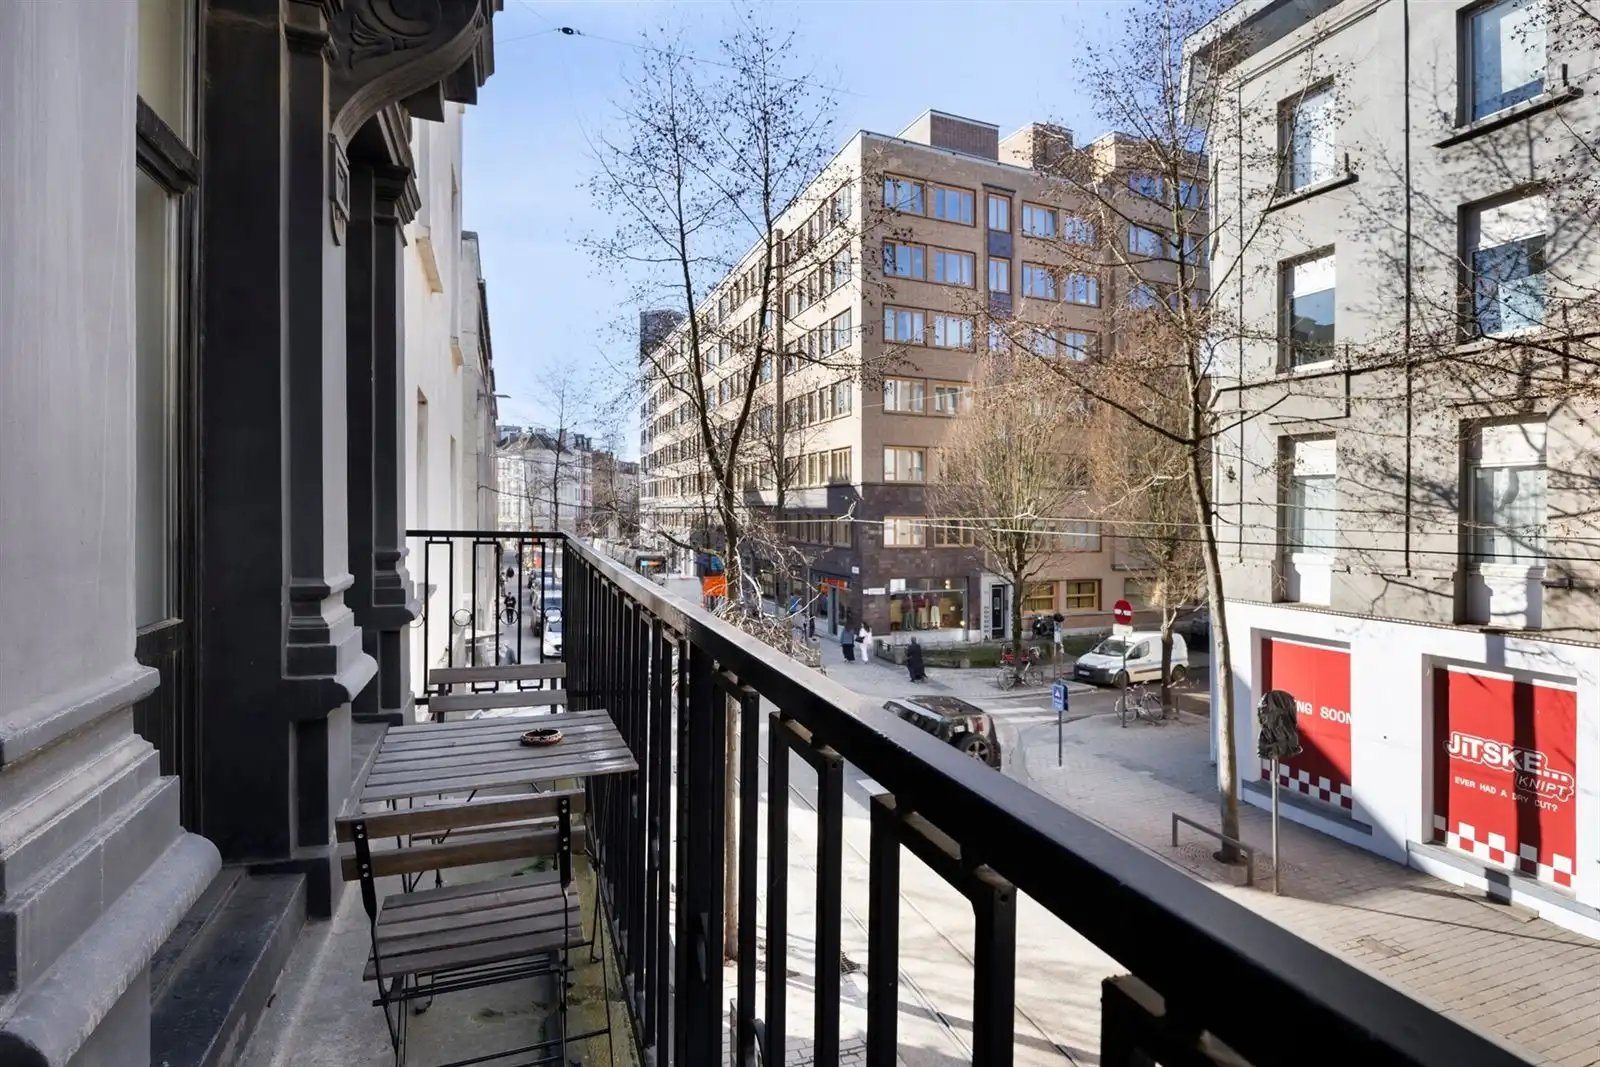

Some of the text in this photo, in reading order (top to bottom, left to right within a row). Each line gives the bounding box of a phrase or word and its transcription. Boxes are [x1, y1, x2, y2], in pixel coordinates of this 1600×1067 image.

[1454, 776, 1558, 812] EVER HAD A DRY CUT?
[1518, 776, 1568, 795] KNIPT
